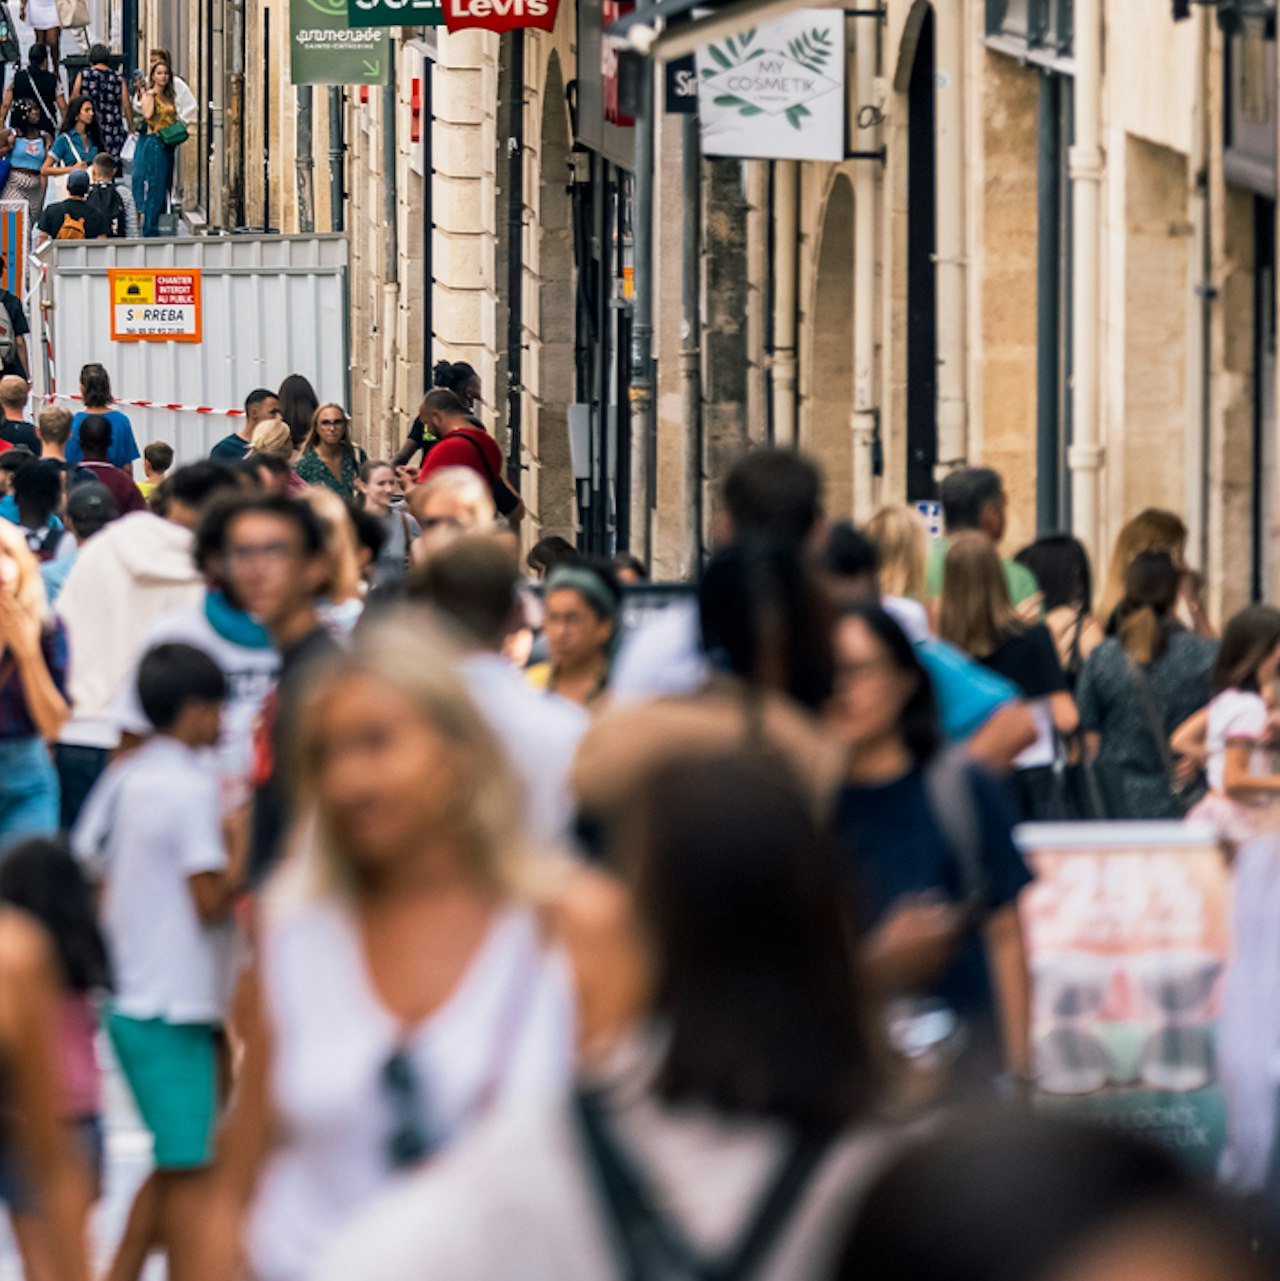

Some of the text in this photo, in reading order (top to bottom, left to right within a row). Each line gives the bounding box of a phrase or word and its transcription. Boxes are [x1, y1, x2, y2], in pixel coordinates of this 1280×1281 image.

[295, 26, 383, 45] promenade
[758, 61, 785, 74] MY
[727, 77, 816, 93] COSMETIK
[157, 276, 193, 284] CHANTIER
[159, 286, 191, 294] INTERDIT
[158, 295, 194, 304] AU PUBLIC
